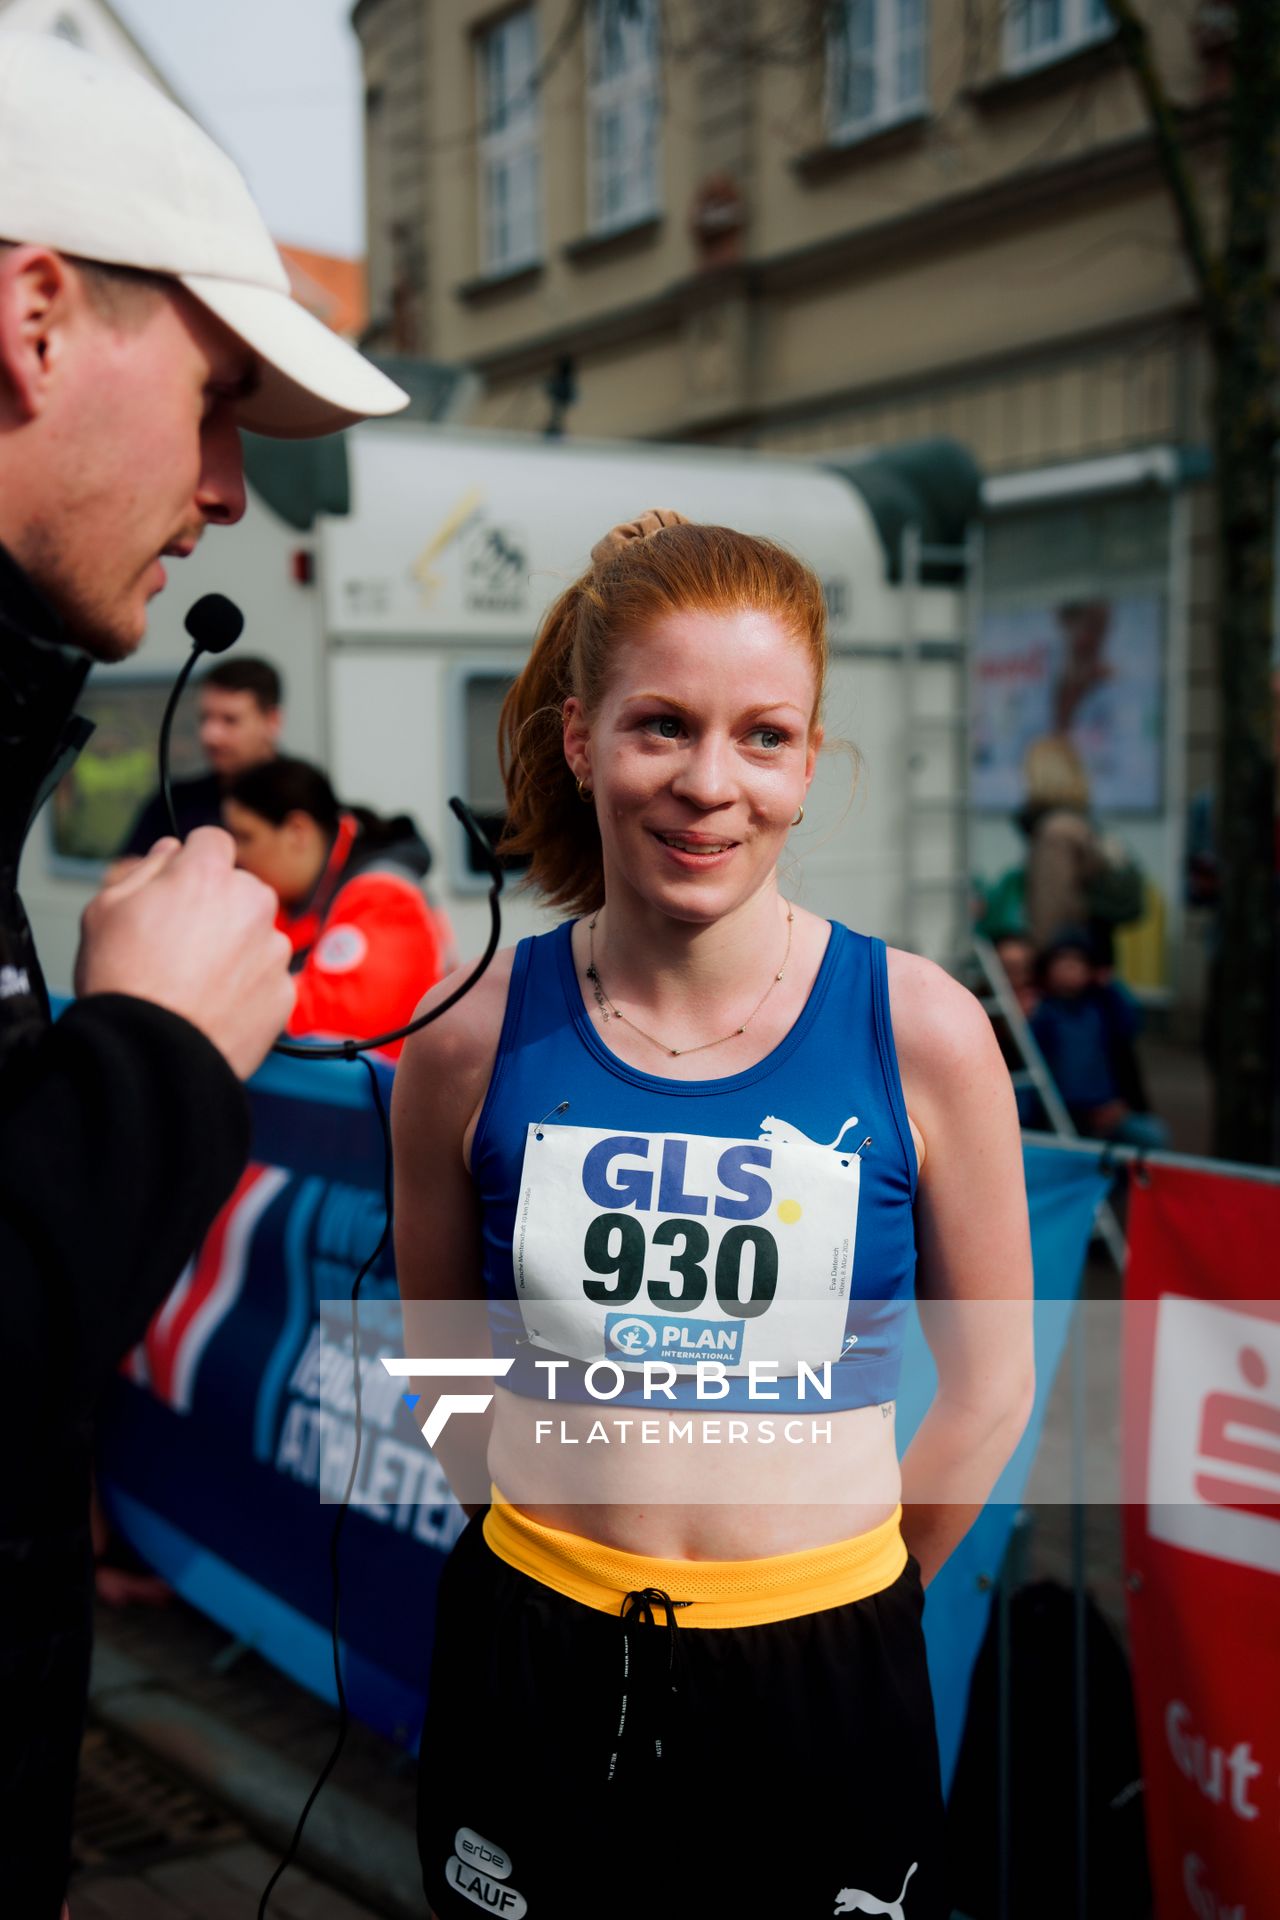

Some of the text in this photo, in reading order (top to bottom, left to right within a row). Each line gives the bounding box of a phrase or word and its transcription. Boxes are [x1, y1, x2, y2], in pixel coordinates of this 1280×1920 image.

[582, 1212, 779, 1319] 930
[660, 1349, 735, 1361] INTERNATIONAL
[661, 1325, 738, 1351] PLAN
[1165, 1699, 1263, 1821] Gut
[462, 1840, 504, 1868] erbe
[456, 1864, 517, 1911] LAUF
